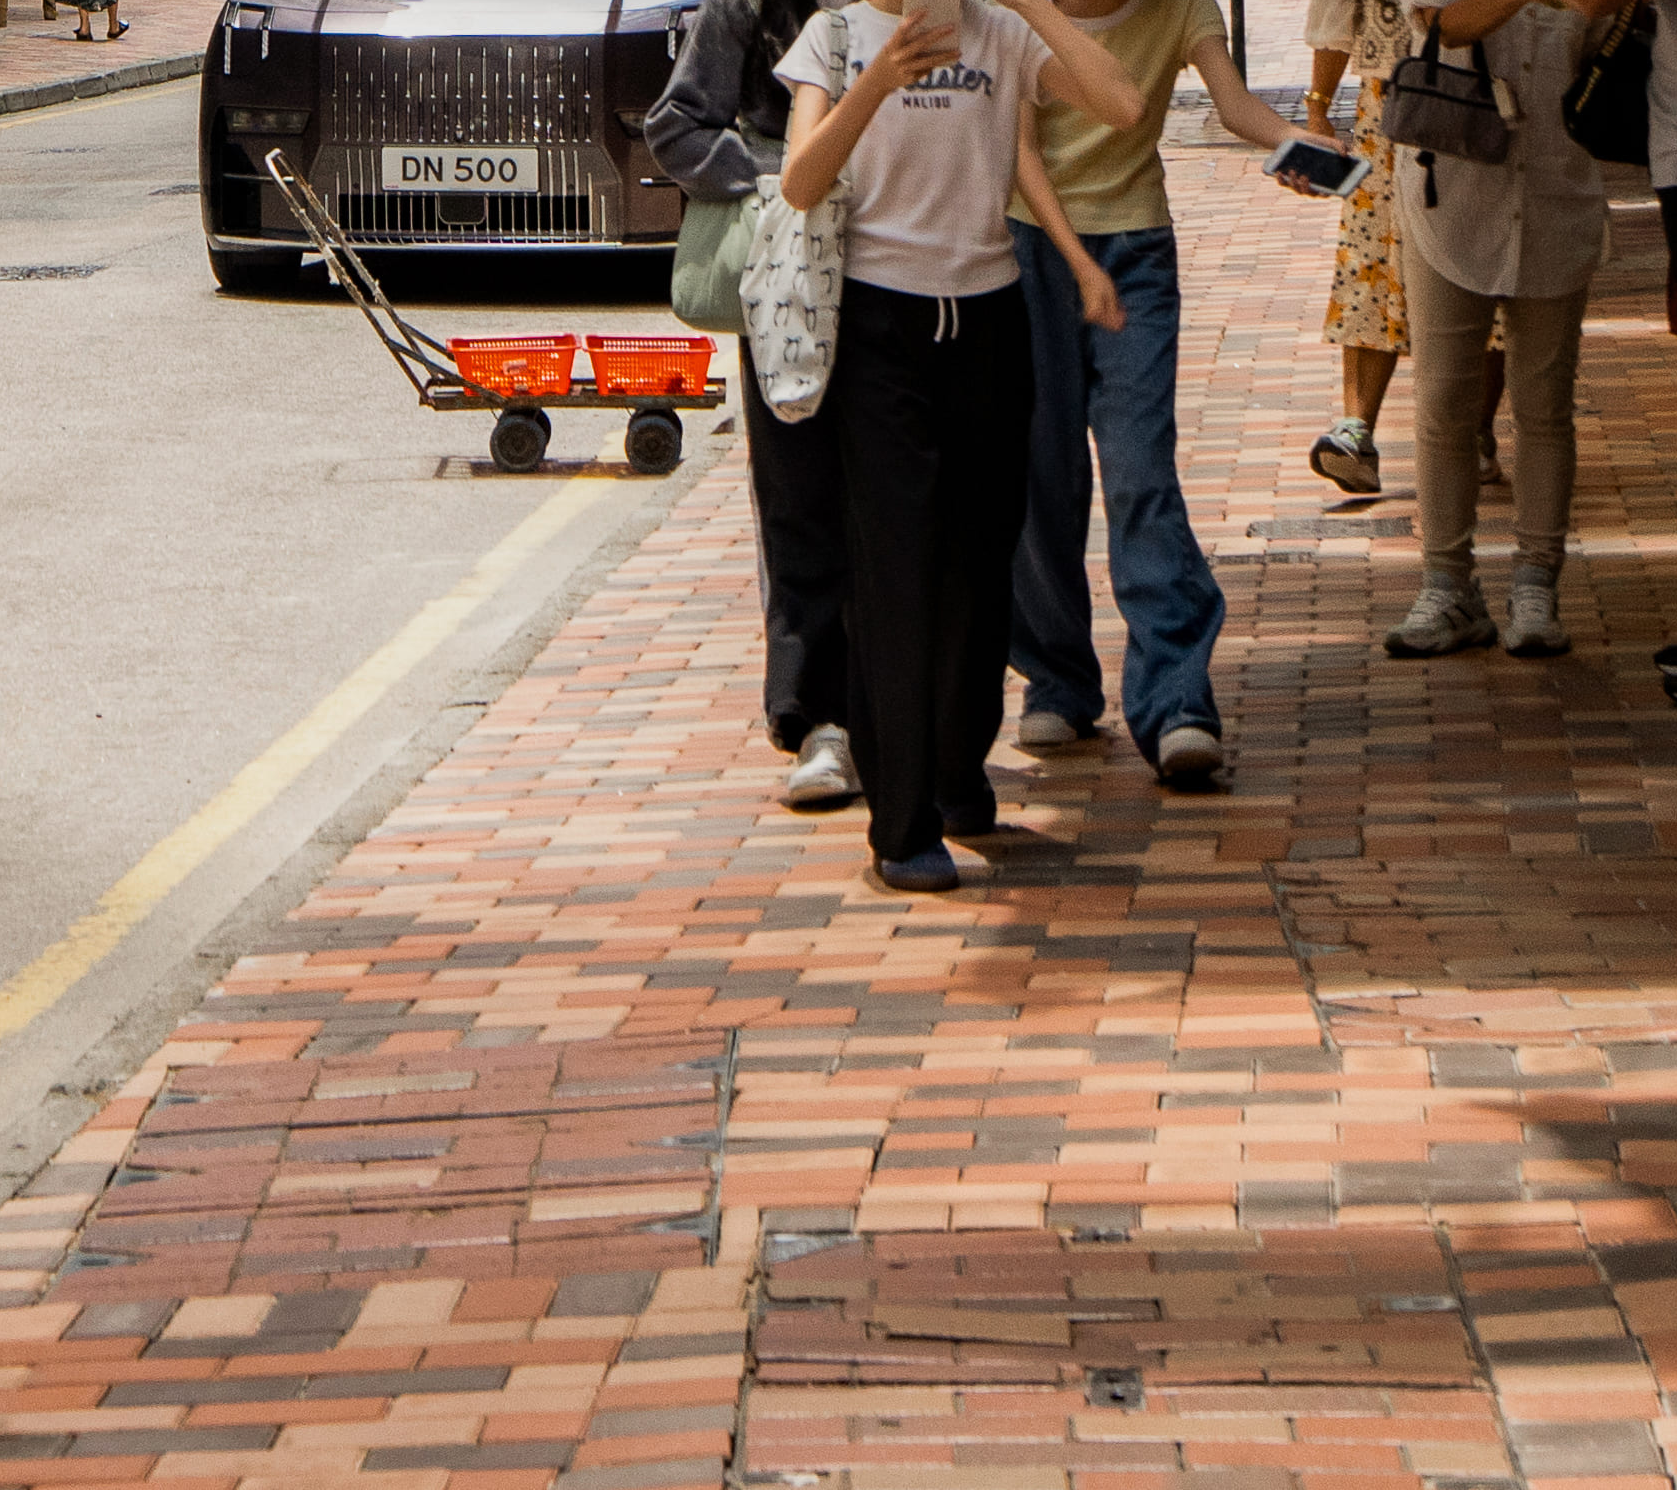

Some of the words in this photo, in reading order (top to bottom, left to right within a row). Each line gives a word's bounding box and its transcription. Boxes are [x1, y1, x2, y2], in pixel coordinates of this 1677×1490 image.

[903, 96, 951, 109] MALIBU
[401, 155, 444, 184] DN
[454, 154, 518, 184] 500
